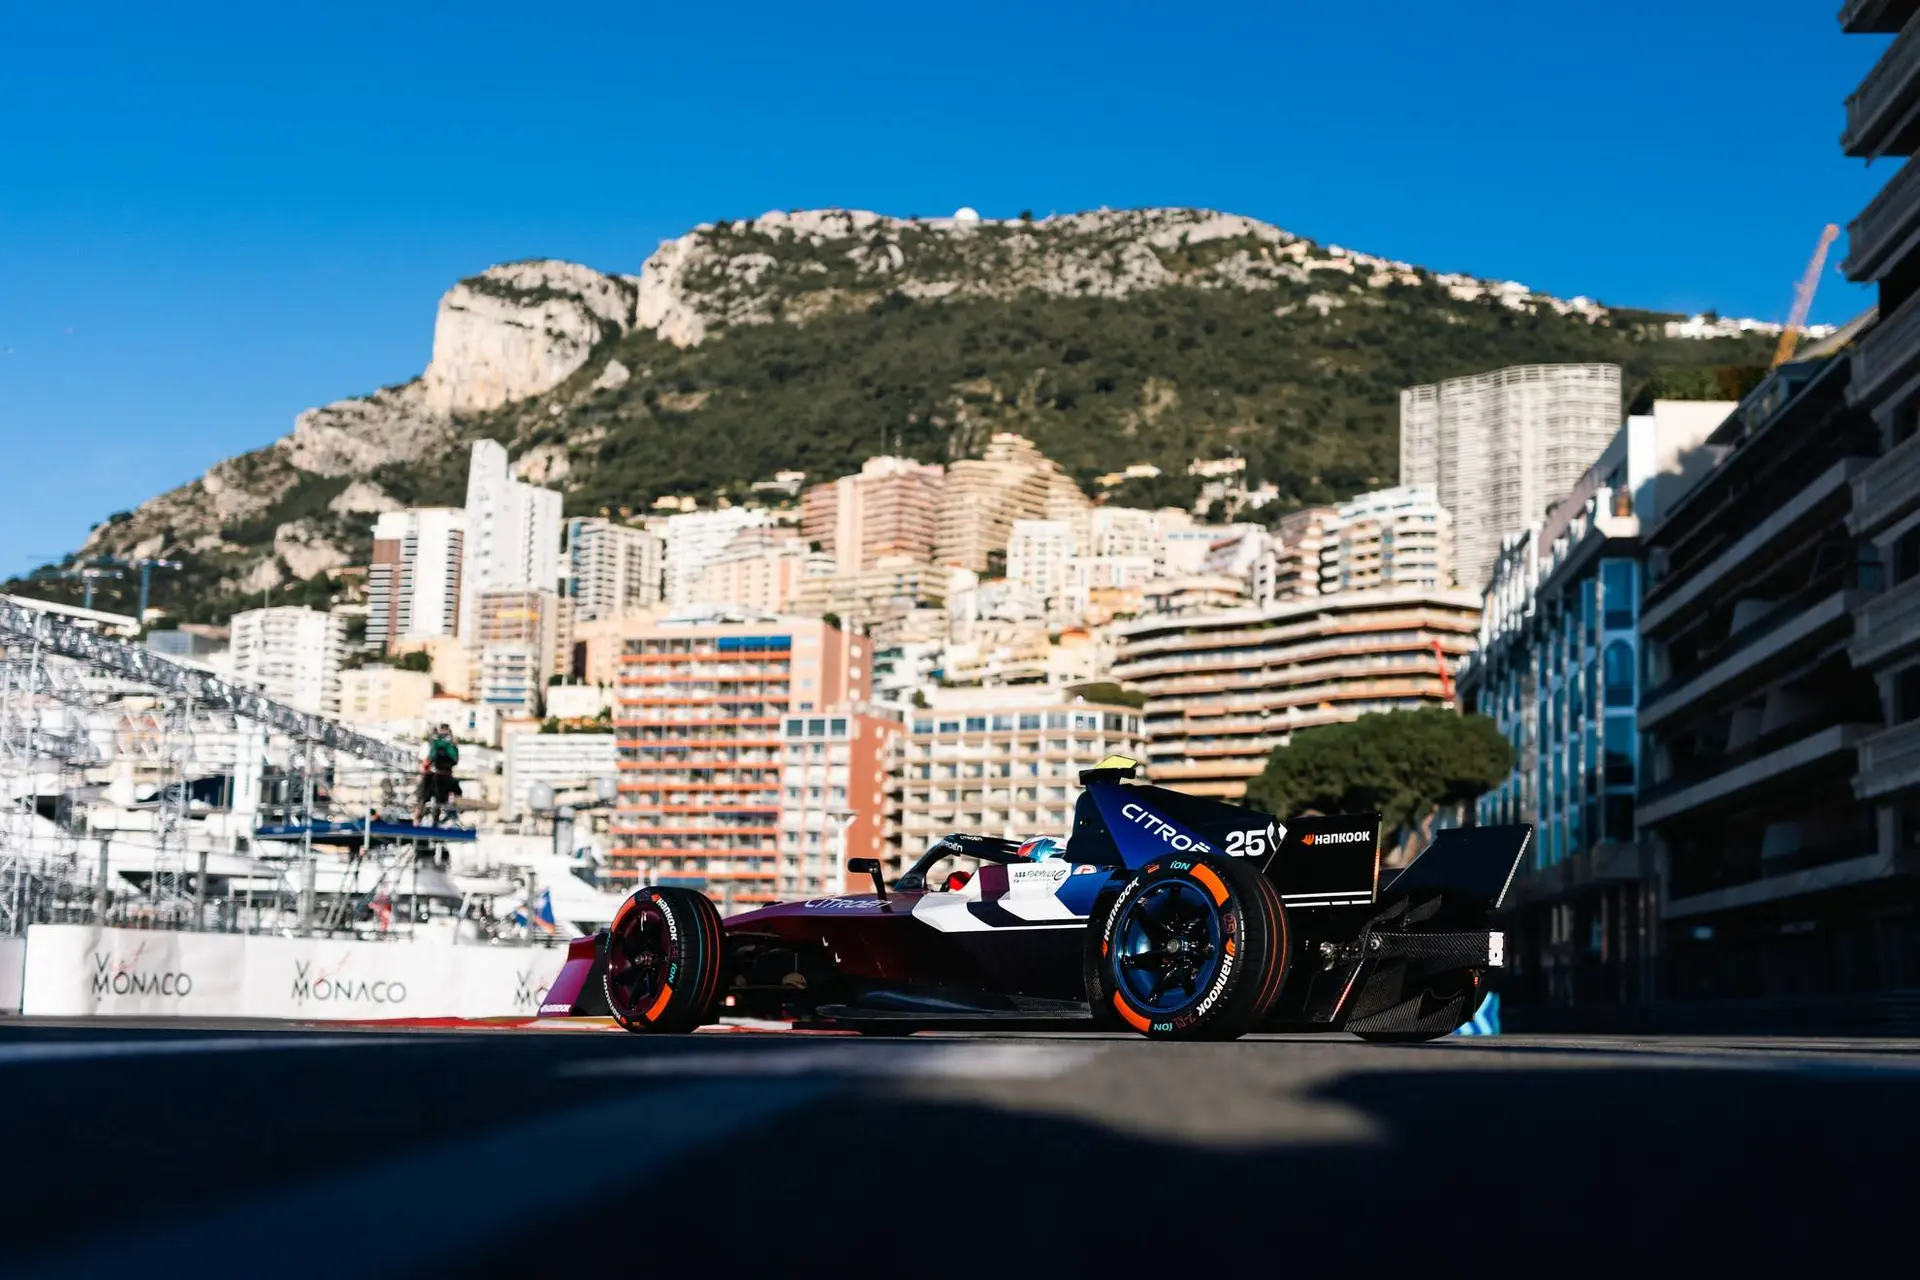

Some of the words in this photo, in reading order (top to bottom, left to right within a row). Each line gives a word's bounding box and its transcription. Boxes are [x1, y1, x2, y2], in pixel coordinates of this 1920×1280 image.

[1121, 803, 1211, 854] CITROË
[1225, 829, 1266, 857] 25
[92, 971, 192, 996] MONACO
[291, 978, 407, 1003] MONACO
